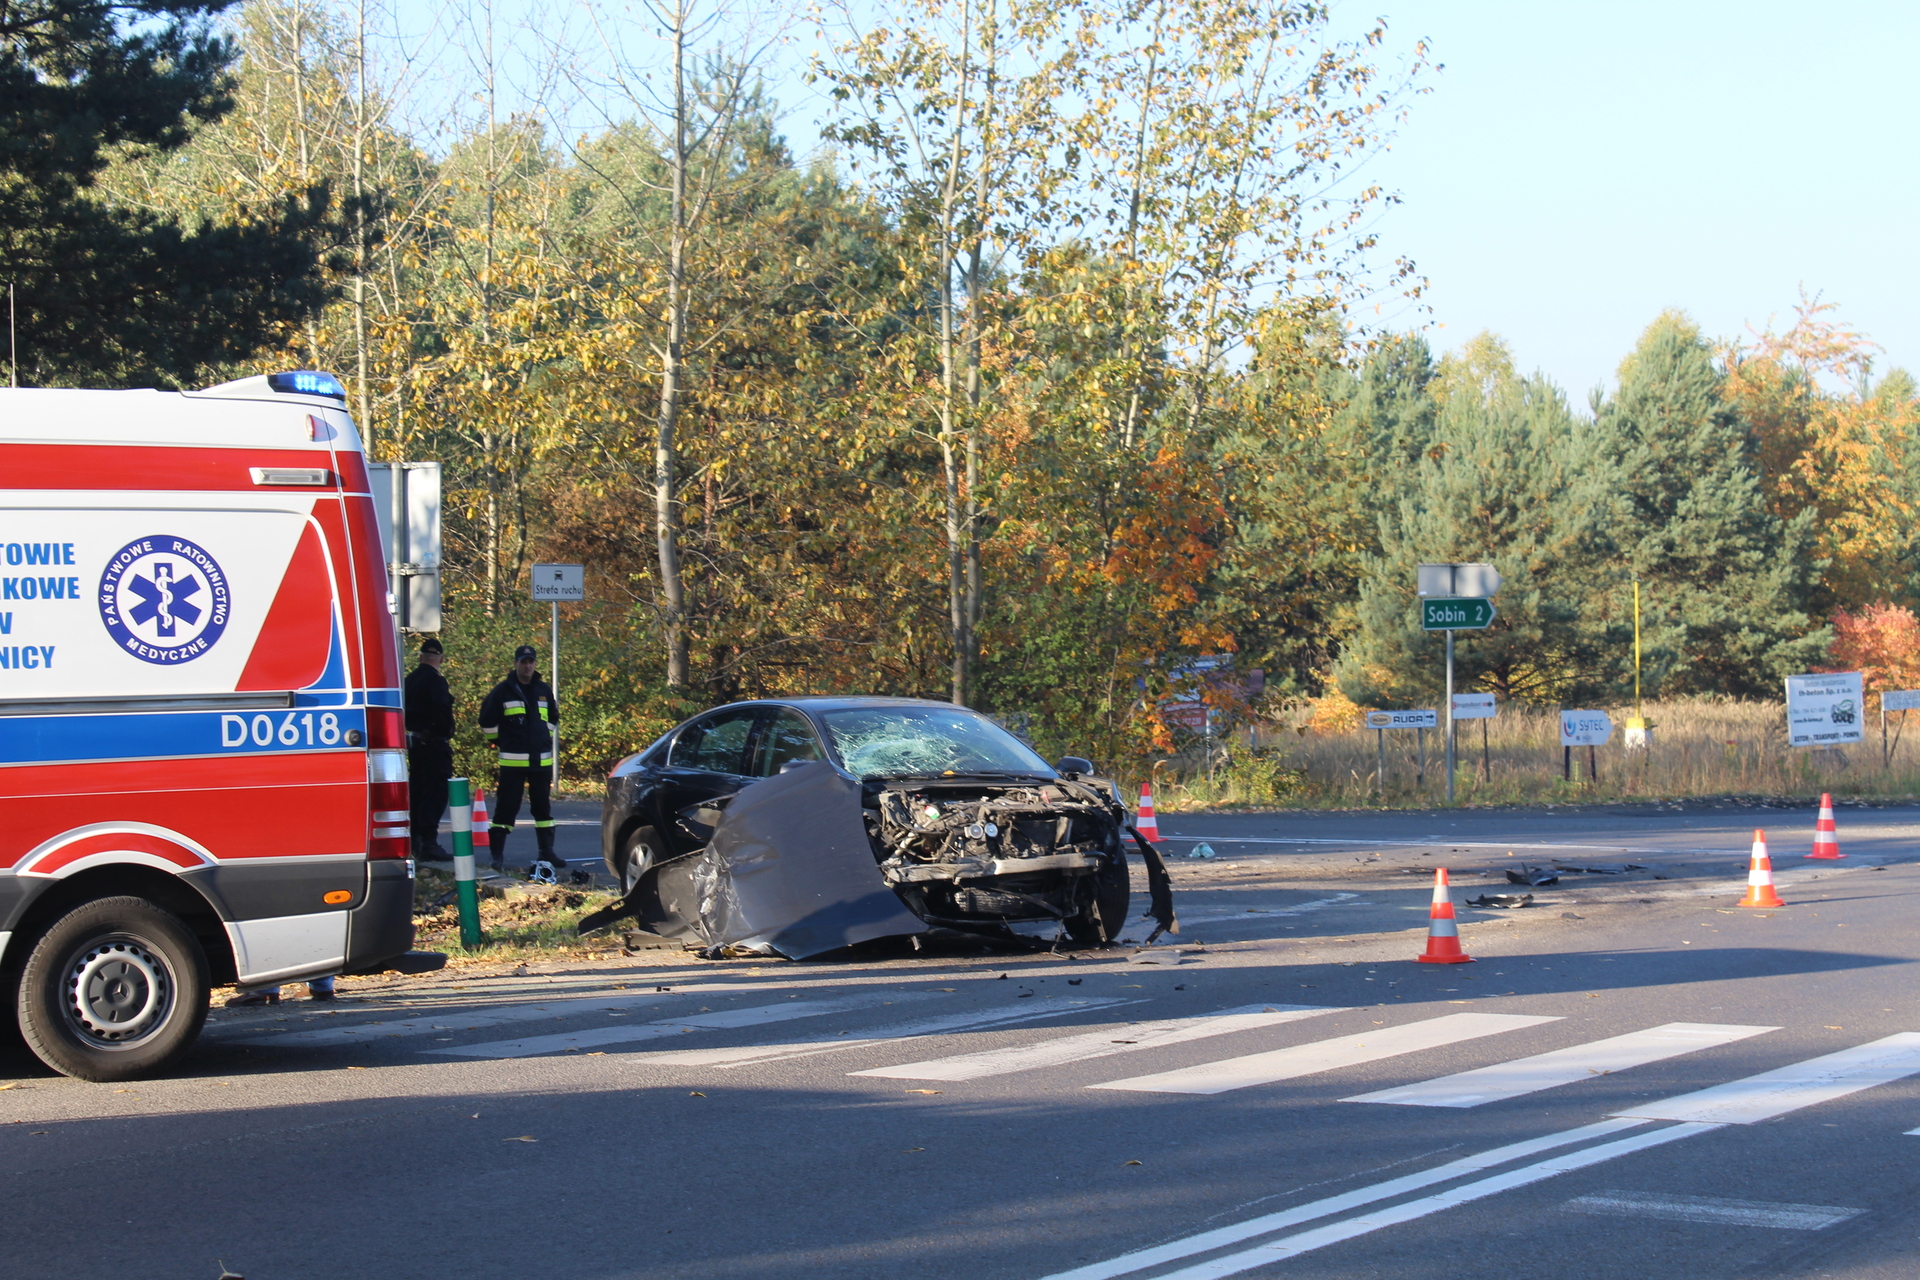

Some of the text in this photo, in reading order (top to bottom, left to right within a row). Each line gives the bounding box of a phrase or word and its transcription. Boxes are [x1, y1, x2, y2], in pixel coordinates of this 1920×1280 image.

[0, 543, 76, 566] OWIE
[101, 541, 154, 626] PAŃSTWOWE
[172, 541, 227, 625] RATOWNICTWO
[535, 584, 582, 595] Strefa ruchu
[1428, 605, 1483, 623] Sobin 2
[126, 637, 208, 661] MEDYCZNE
[221, 712, 341, 747] D0618
[1393, 715, 1424, 724] RUDA
